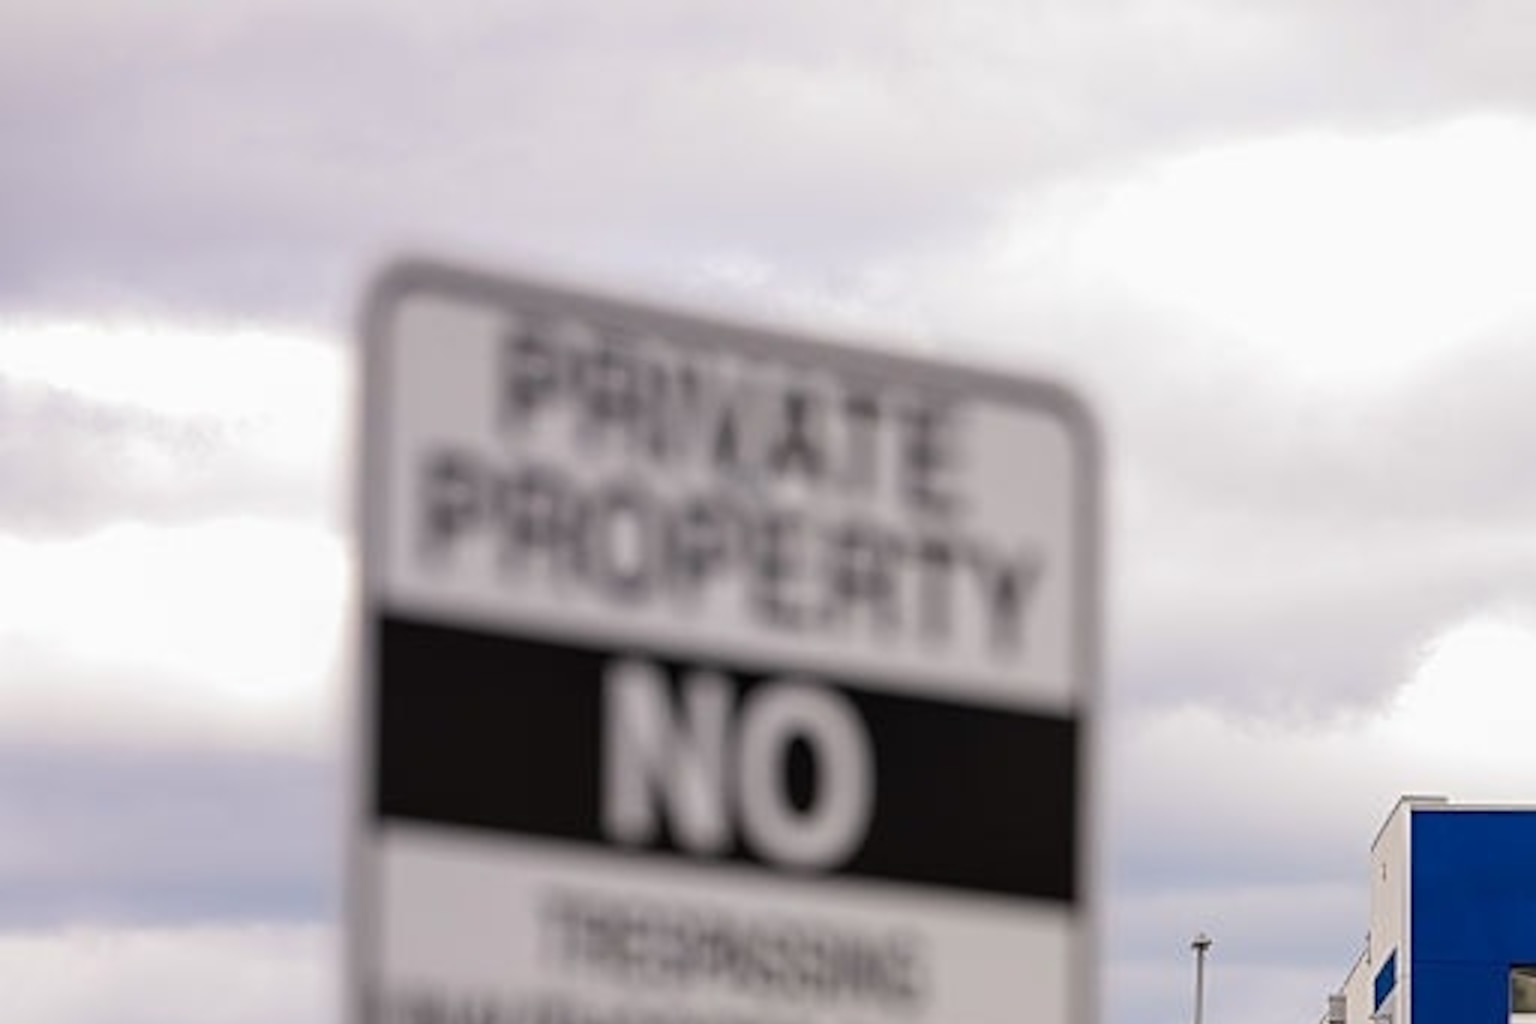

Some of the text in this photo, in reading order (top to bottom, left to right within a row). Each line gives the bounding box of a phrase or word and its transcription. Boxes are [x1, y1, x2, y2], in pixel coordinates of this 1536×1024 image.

[503, 312, 964, 516] PRIVATE
[420, 448, 1042, 658] PROPERTY
[605, 656, 874, 872] NO
